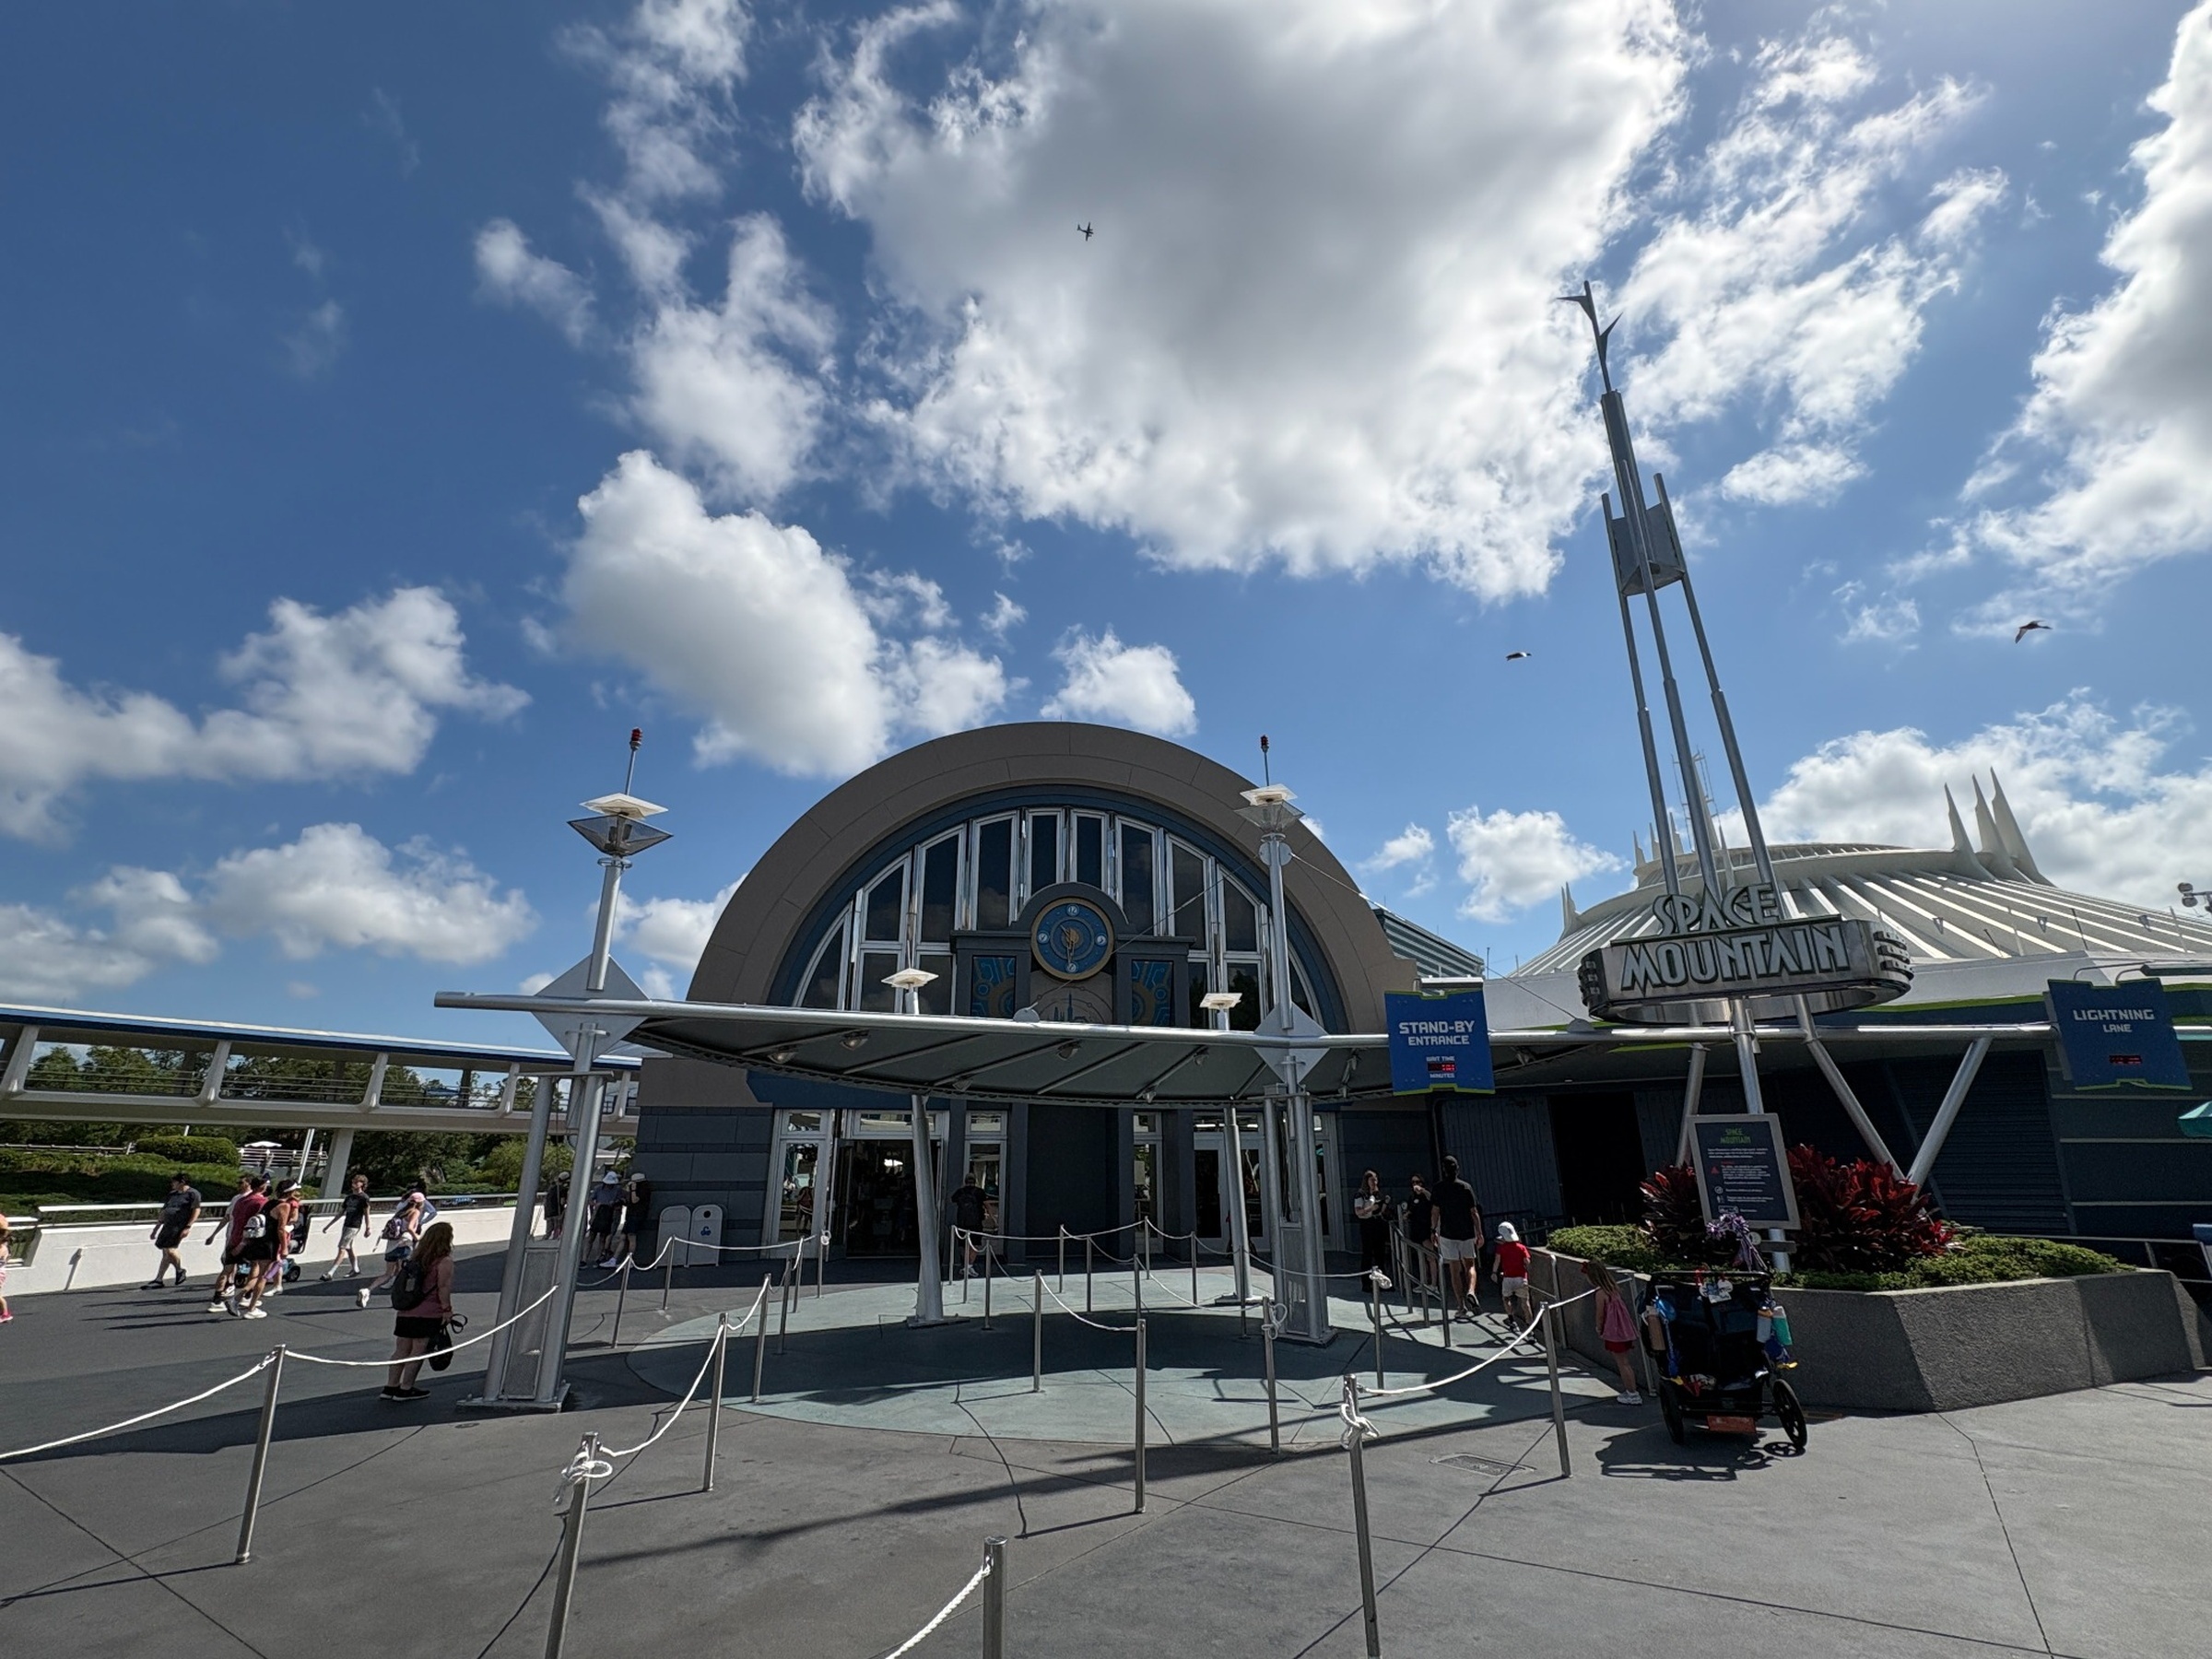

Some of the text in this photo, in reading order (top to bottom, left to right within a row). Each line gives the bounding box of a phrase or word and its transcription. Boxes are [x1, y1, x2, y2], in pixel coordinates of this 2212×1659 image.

[1652, 880, 1780, 935] SPACE
[1620, 924, 1850, 997] MOUNTAIN
[2073, 1009, 2155, 1020] LIGHTNING
[1399, 1020, 1475, 1034] STAND-BY
[2102, 1024, 2132, 1032] LANE
[1408, 1035, 1470, 1046] ENTRANCE
